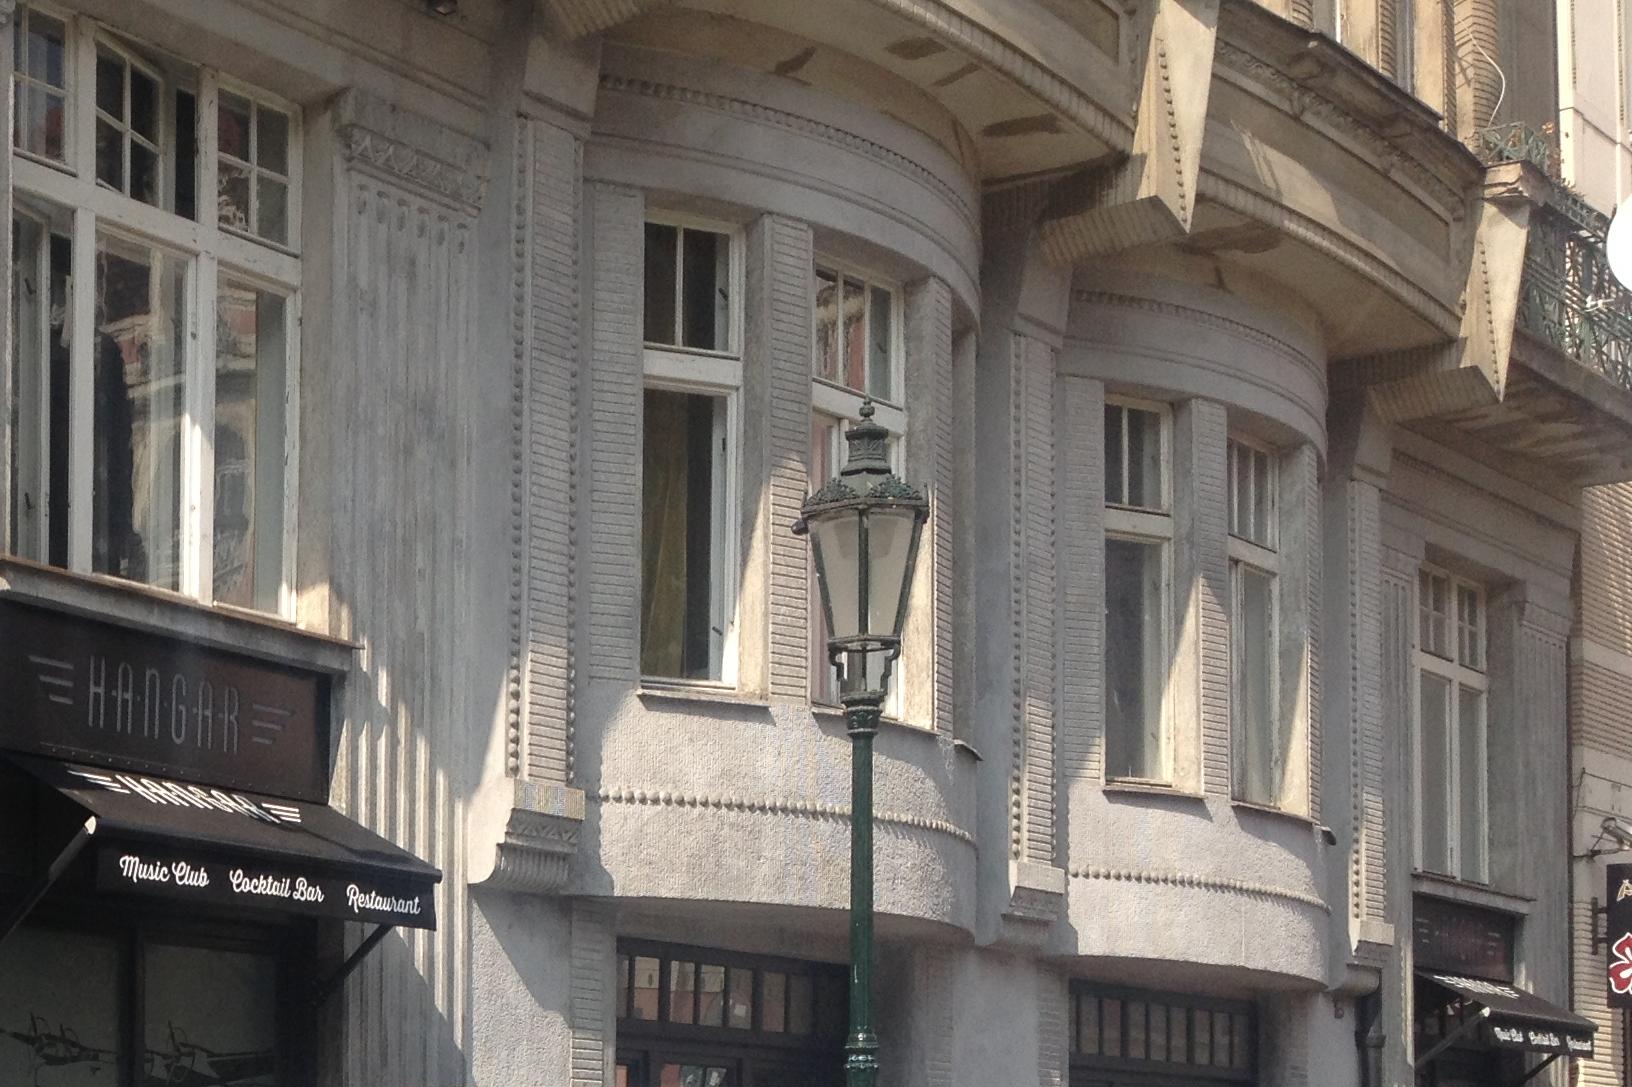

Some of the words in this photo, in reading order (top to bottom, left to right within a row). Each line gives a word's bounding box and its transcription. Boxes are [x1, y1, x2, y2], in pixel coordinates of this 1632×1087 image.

[88, 655, 240, 754] HANGAR
[119, 855, 170, 883] Music
[171, 861, 210, 887] Club
[229, 869, 291, 898] Cocktail
[292, 877, 325, 902] Bar
[346, 884, 421, 916] Restaurant
